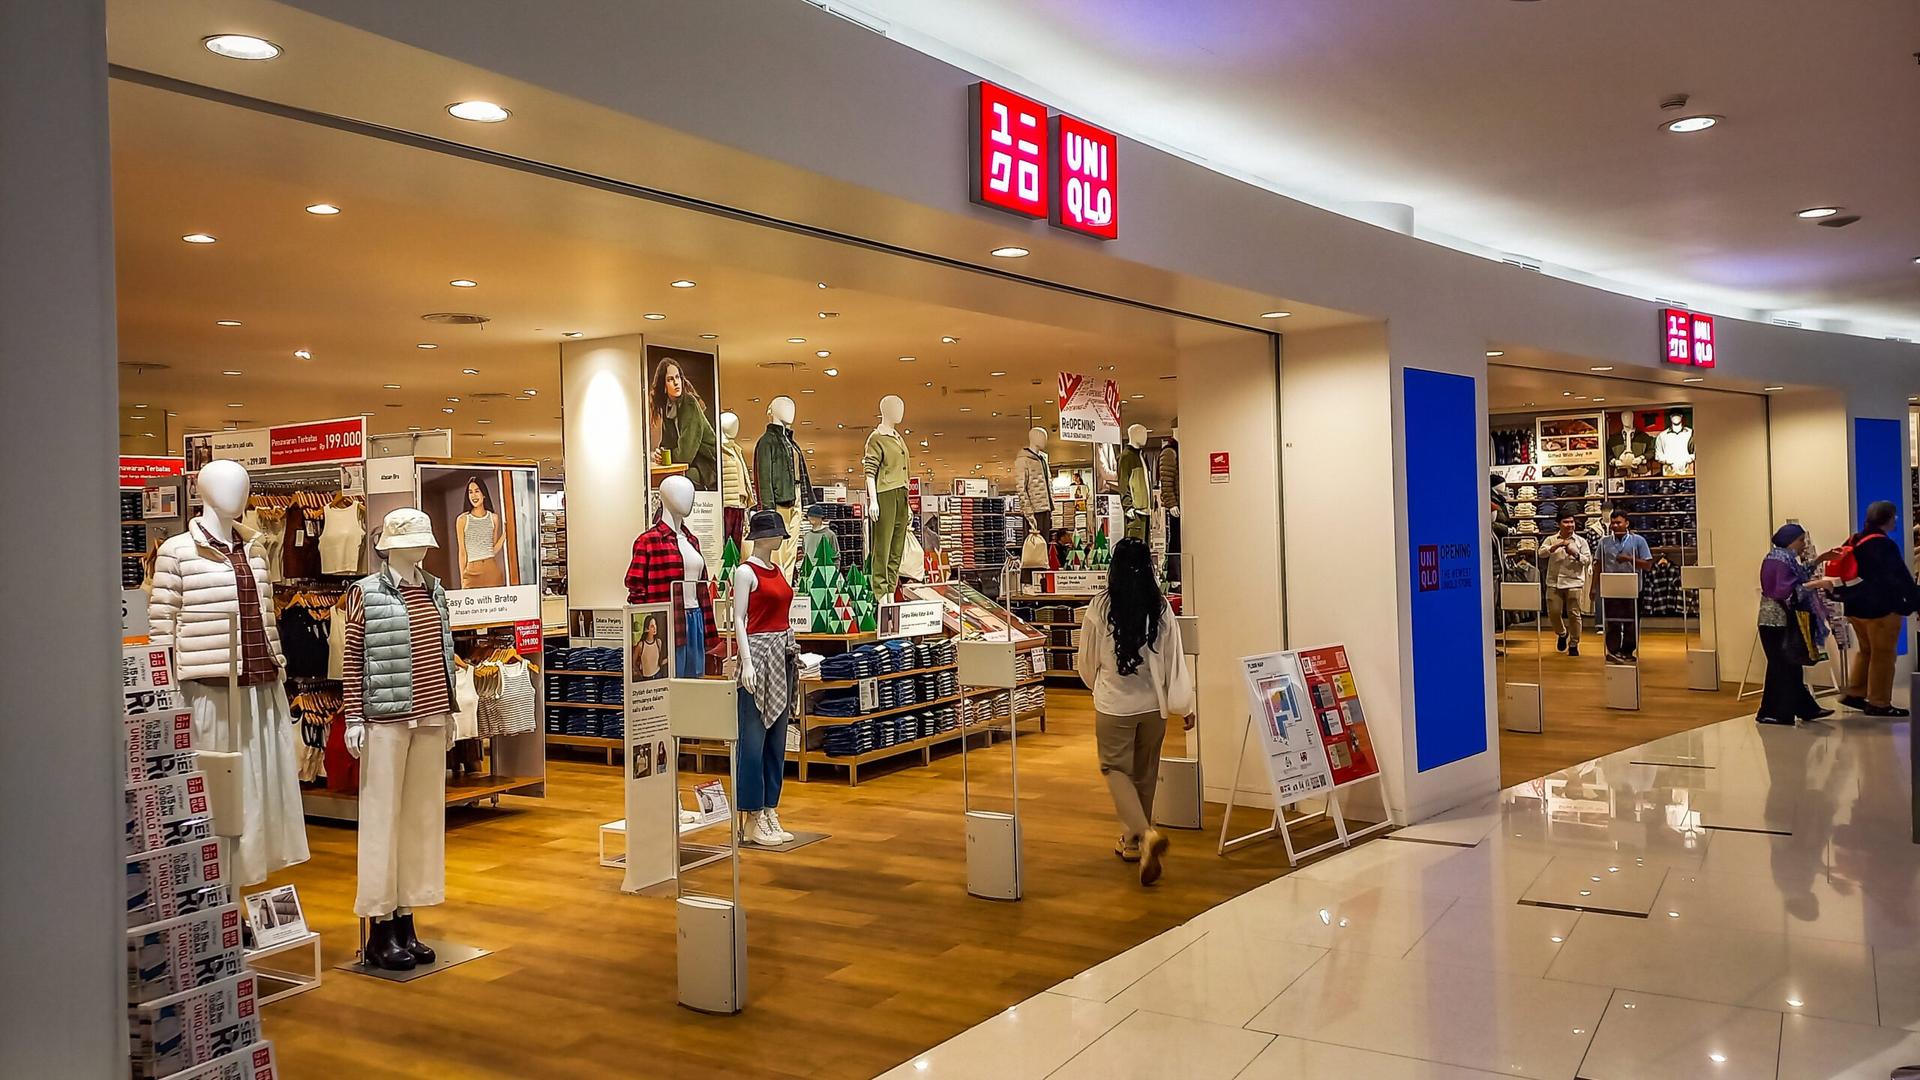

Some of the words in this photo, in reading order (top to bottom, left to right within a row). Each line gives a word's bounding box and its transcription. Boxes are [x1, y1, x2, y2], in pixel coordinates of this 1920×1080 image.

[991, 102, 1038, 155] ユニ
[1067, 131, 1107, 181] UNI
[990, 151, 1038, 202] クロ
[1067, 177, 1112, 223] QLO
[1694, 320, 1710, 341] UNI
[1695, 341, 1713, 363] QLO
[1062, 417, 1095, 431] ReOPENING
[271, 438, 297, 446] Penawaran
[297, 435, 318, 443] Terbatas
[319, 443, 325, 451] Rp
[325, 431, 361, 450] 199.000
[1420, 551, 1436, 567] UNI
[1440, 543, 1472, 559] OPENING
[1421, 570, 1437, 588] QLO
[464, 597, 475, 606] Go
[477, 595, 493, 604] with
[494, 593, 518, 604] Bratop
[130, 667, 138, 676] 15
[152, 730, 161, 739] 15
[129, 727, 140, 763] UNIQLO
[167, 795, 176, 804] 15
[145, 794, 156, 830] UNIQLO
[181, 862, 191, 872] 15
[211, 863, 219, 878] UNI
[158, 863, 170, 900] UNIQLO
[200, 931, 210, 941] 15
[178, 932, 188, 969] UNIQLO
[216, 1001, 225, 1011] 15
[193, 1003, 204, 1041] UNIQLO
